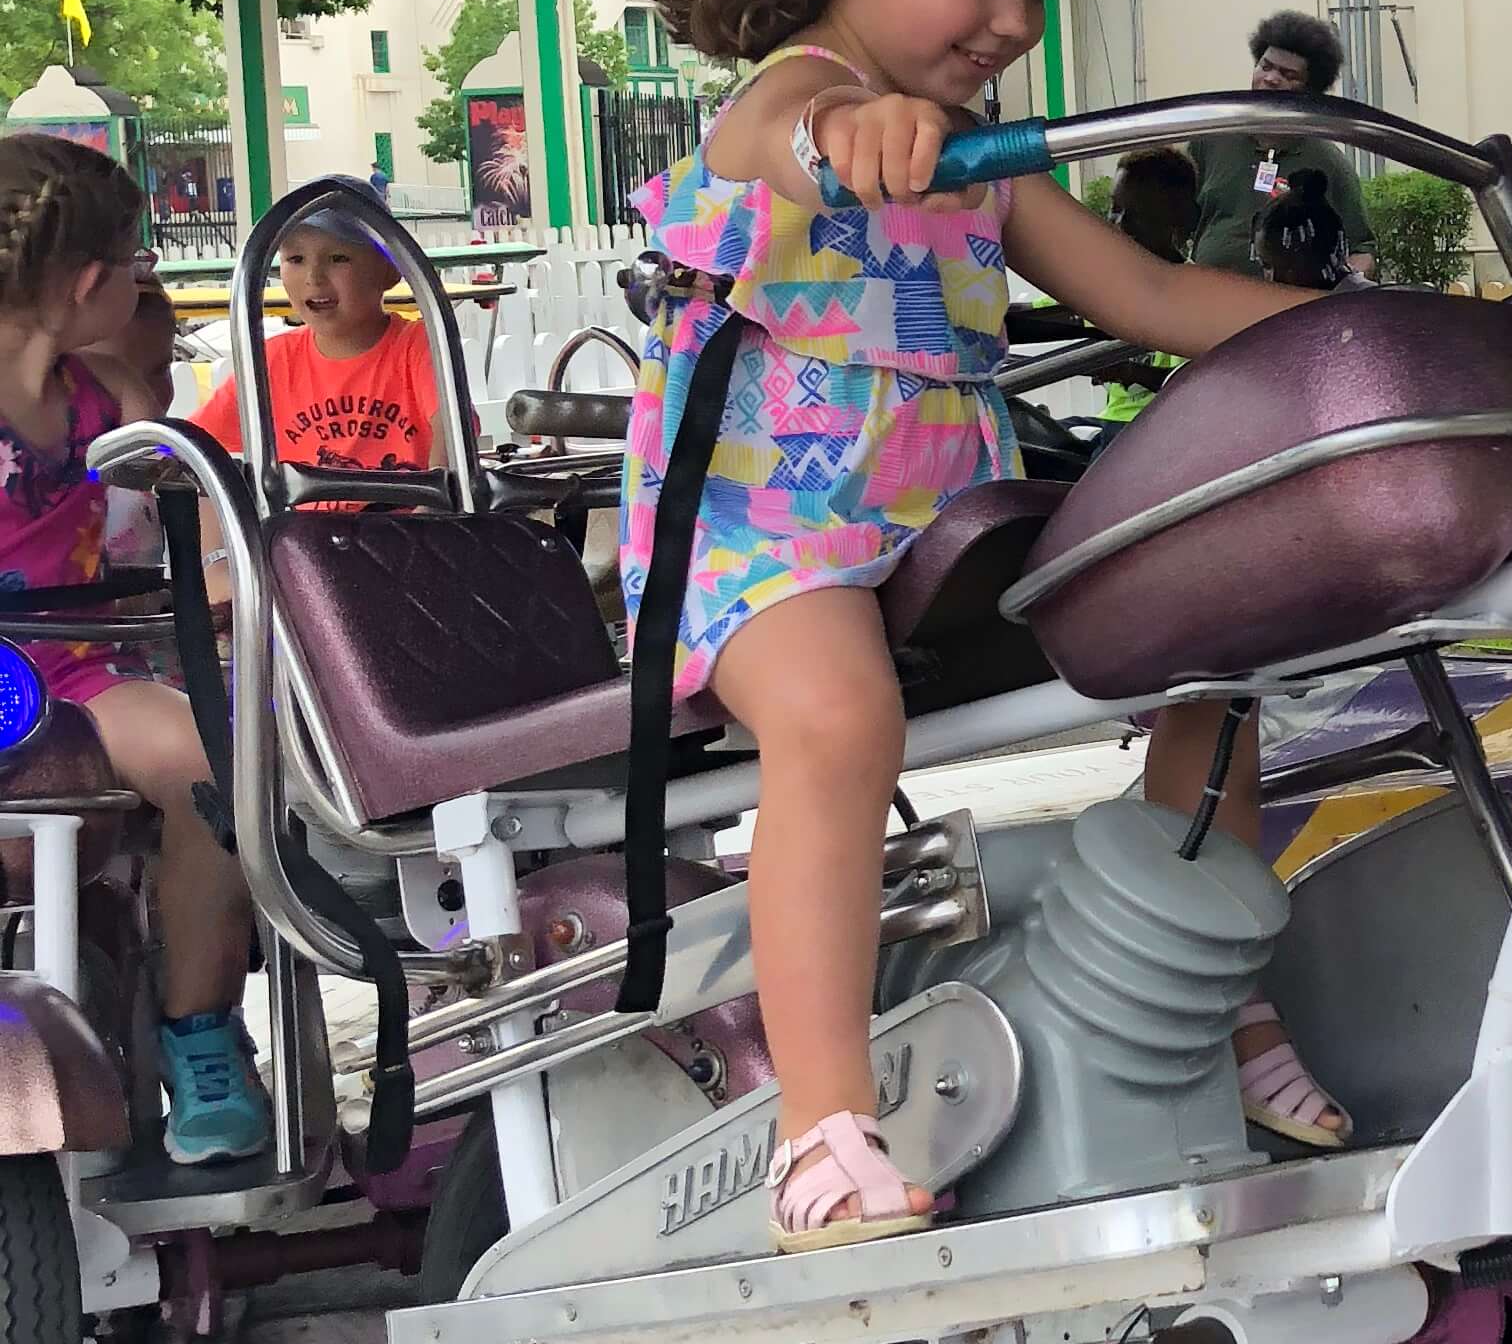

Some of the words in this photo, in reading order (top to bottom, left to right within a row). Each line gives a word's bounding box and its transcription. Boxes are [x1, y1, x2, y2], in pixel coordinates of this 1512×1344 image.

[284, 394, 419, 445] ALBUQUERQUE
[316, 419, 389, 441] CROSS
[911, 783, 995, 803] STE
